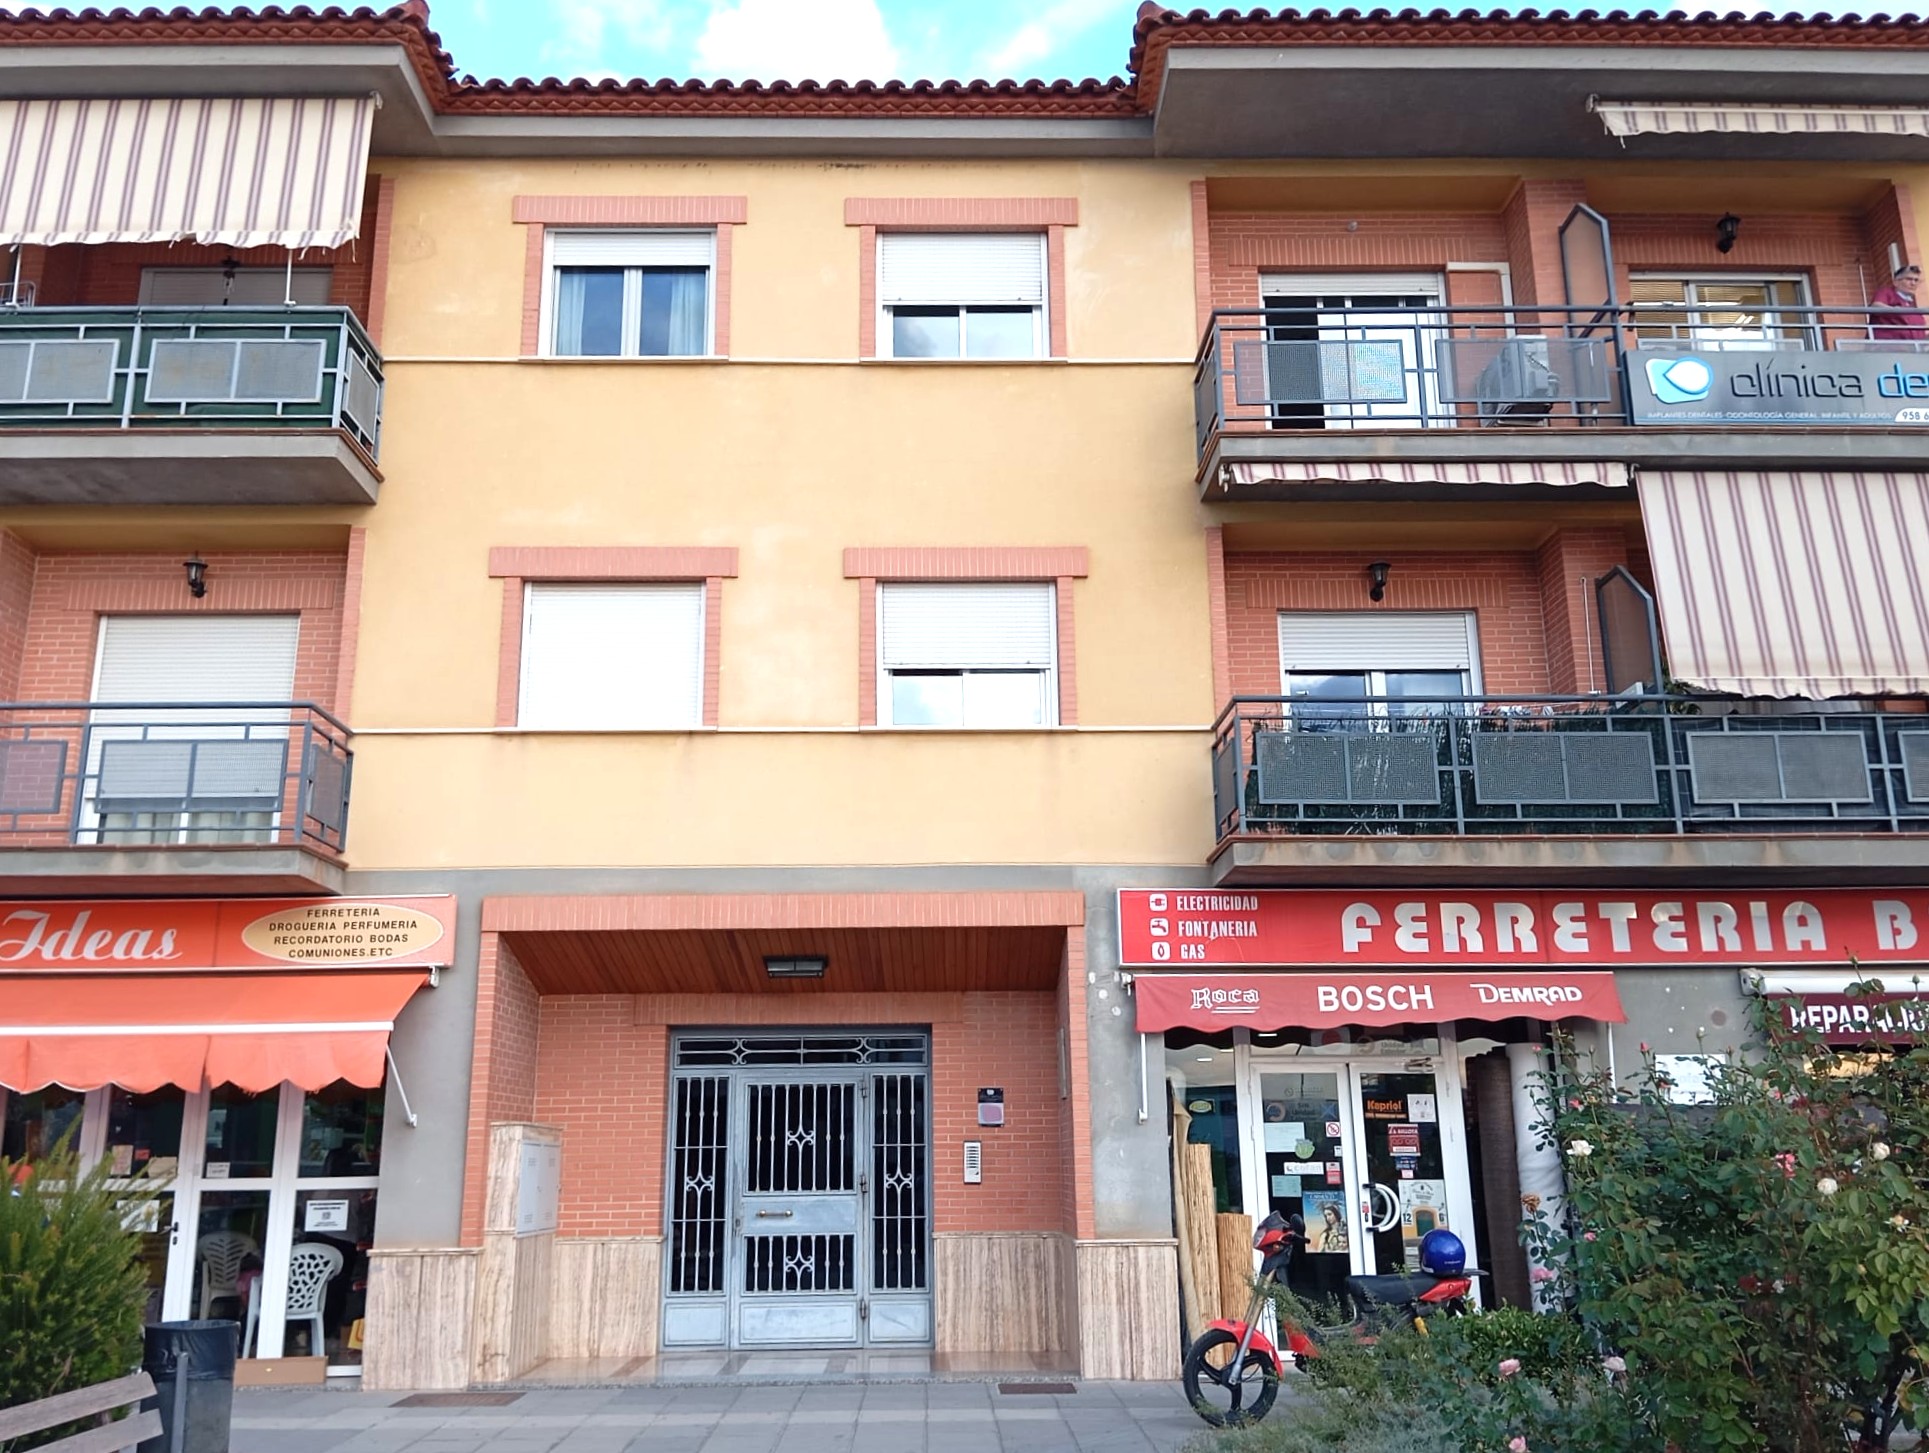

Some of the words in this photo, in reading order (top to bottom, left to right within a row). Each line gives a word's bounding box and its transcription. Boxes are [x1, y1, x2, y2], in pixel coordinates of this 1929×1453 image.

[1730, 358, 1865, 398] clínica
[1902, 411, 1920, 421] 958
[1176, 896, 1259, 912] ELECTRICIDAD
[306, 908, 381, 918] FERRETERIA
[269, 921, 337, 932] DROGUERIA
[343, 920, 418, 930] PERFUMERIA
[1178, 920, 1259, 938] FONTANERIA
[1340, 899, 1828, 953] FERRETERIA
[0, 909, 183, 962] Ideas
[273, 934, 364, 945] RECORDATORIO
[369, 933, 409, 943] BODAS
[1180, 943, 1206, 960] GAS
[1190, 987, 1260, 1010] Roca
[1317, 985, 1435, 1012] BOSCH
[1403, 1213, 1412, 1222] 12
